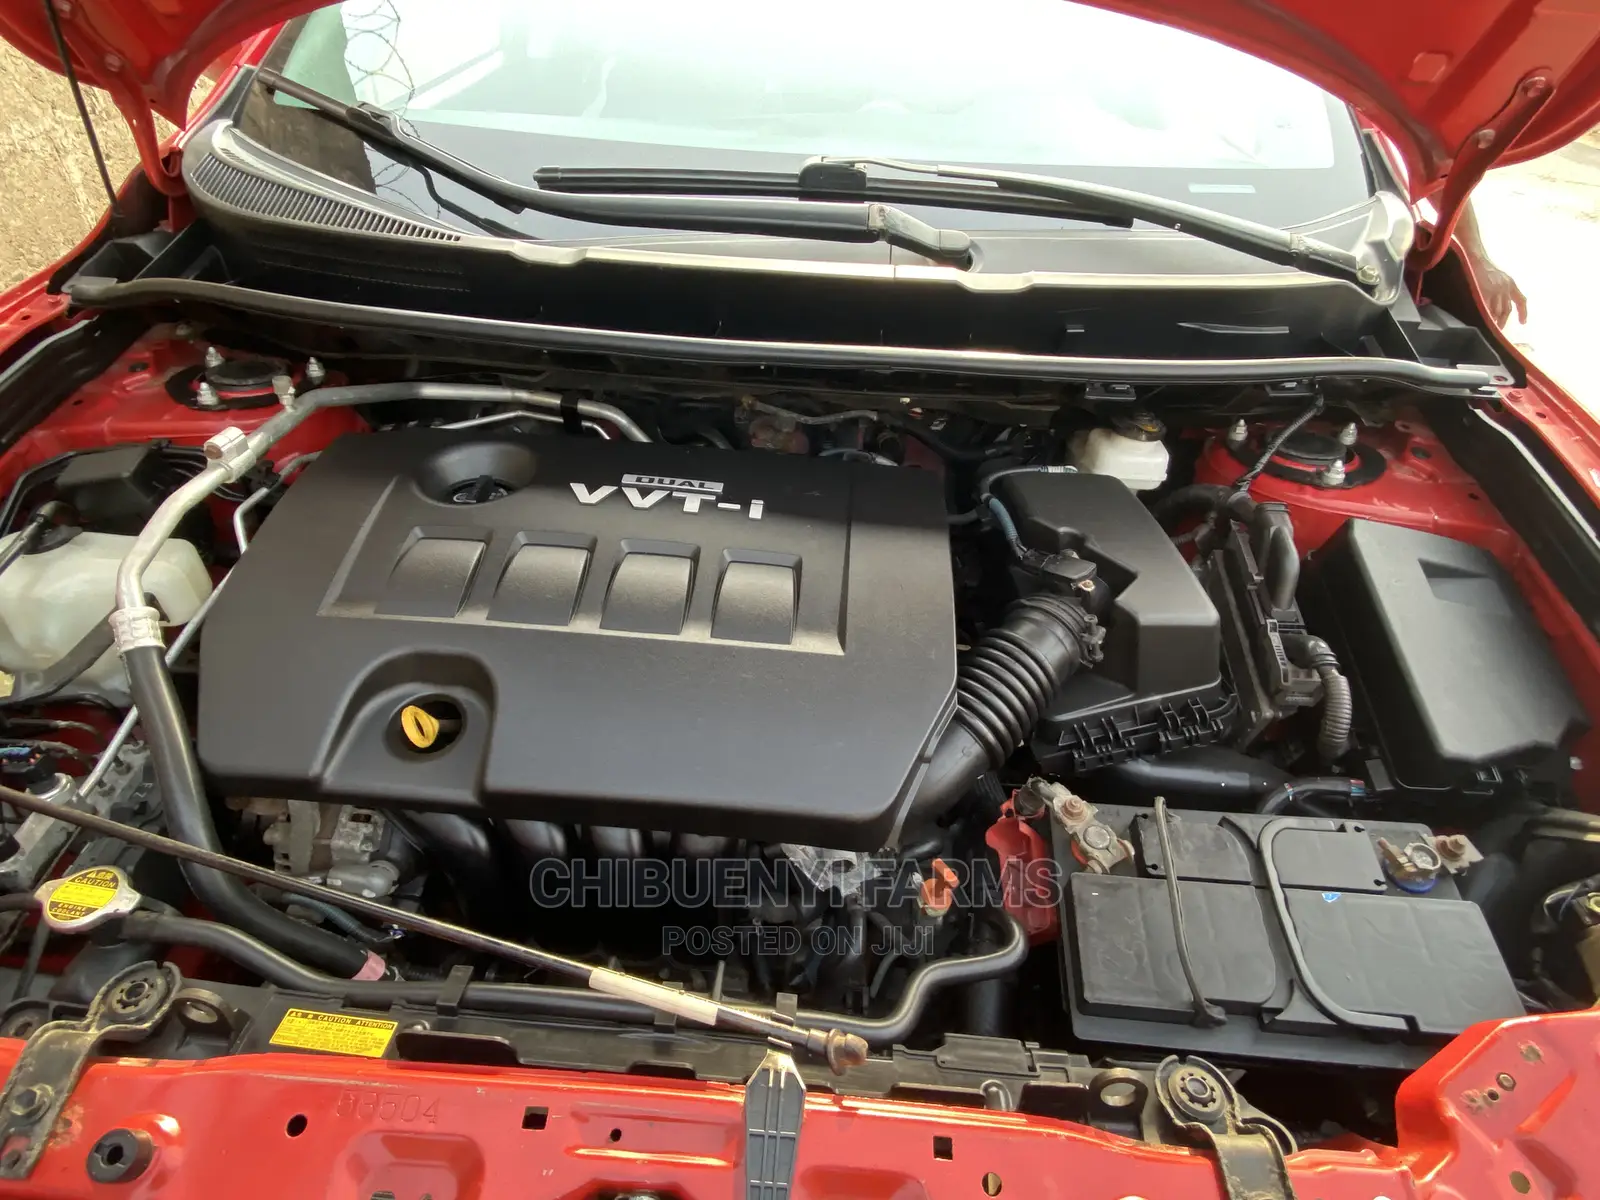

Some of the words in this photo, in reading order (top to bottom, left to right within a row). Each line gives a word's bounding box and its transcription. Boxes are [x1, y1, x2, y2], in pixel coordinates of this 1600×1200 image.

[635, 476, 715, 490] DUAL
[75, 876, 116, 888] CAUTION
[318, 1014, 352, 1024] CAUTION
[356, 1019, 394, 1029] ATTENTION
